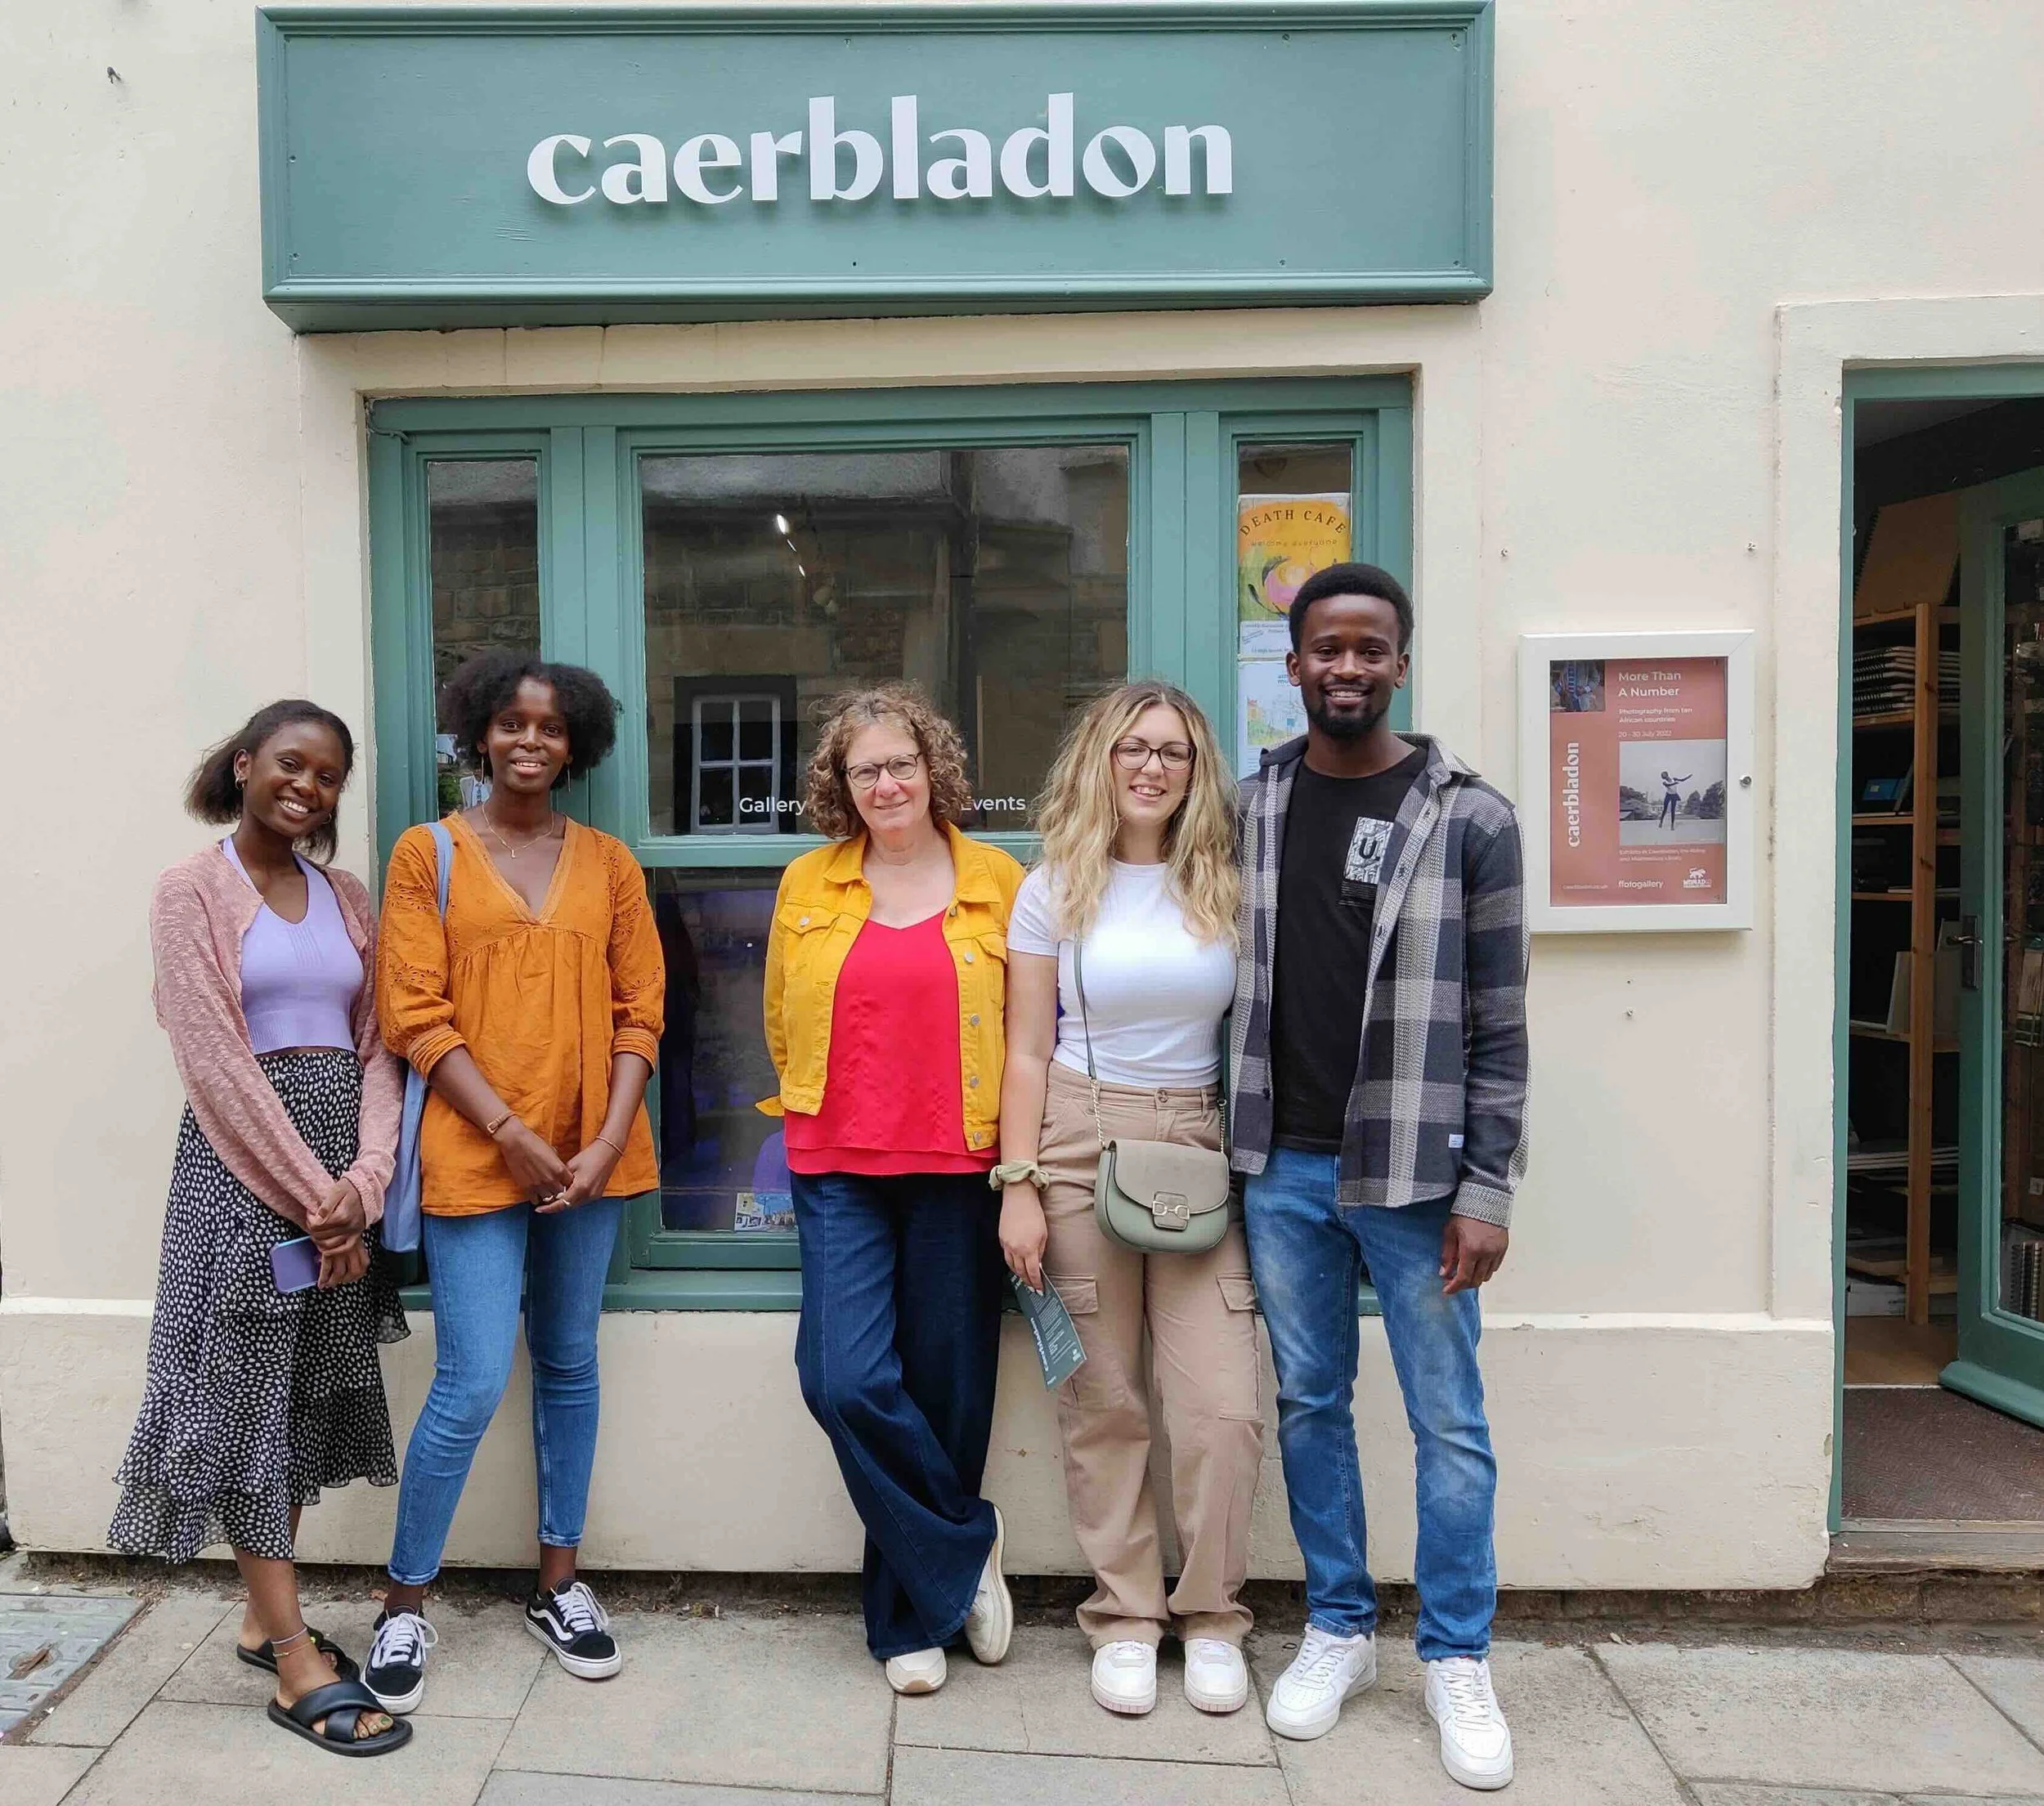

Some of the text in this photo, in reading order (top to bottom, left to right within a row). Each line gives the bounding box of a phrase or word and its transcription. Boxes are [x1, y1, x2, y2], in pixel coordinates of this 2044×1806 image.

[527, 92, 1233, 204] caerbladon
[1239, 509, 1347, 536] DEATH CAFE
[1619, 670, 1681, 682] More Than
[1618, 686, 1680, 697] A Number
[1619, 707, 1662, 715] Photography
[1562, 742, 1580, 847] caerbladon
[739, 796, 807, 816] Gallery
[1618, 880, 1664, 890] ffotogallery
